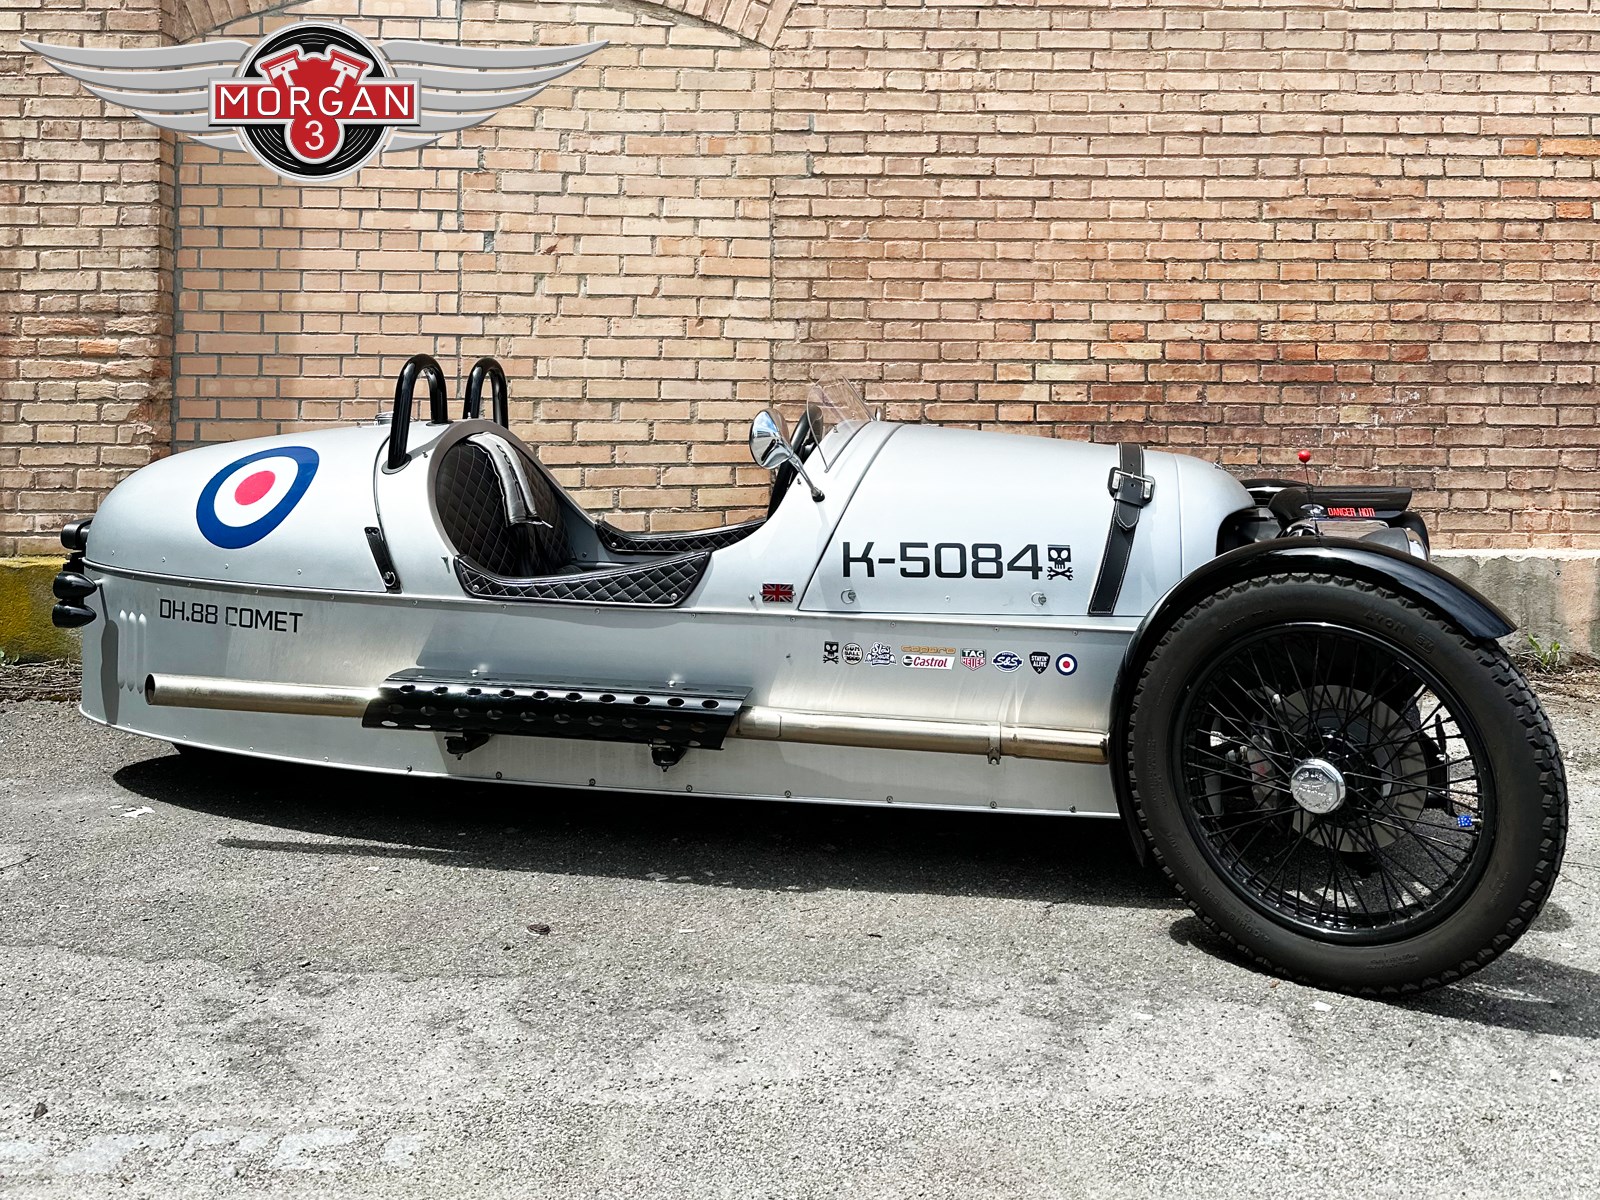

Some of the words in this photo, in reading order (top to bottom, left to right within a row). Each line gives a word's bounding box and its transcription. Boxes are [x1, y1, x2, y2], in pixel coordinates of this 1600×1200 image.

[1327, 507, 1356, 517] DANGER
[843, 542, 1043, 580] K-5084
[160, 598, 218, 626] DH.88
[225, 606, 303, 633] COMET
[963, 650, 983, 658] TAG
[913, 656, 947, 667] Castrol
[962, 658, 985, 669] HEUER
[996, 656, 1019, 666] S&S
